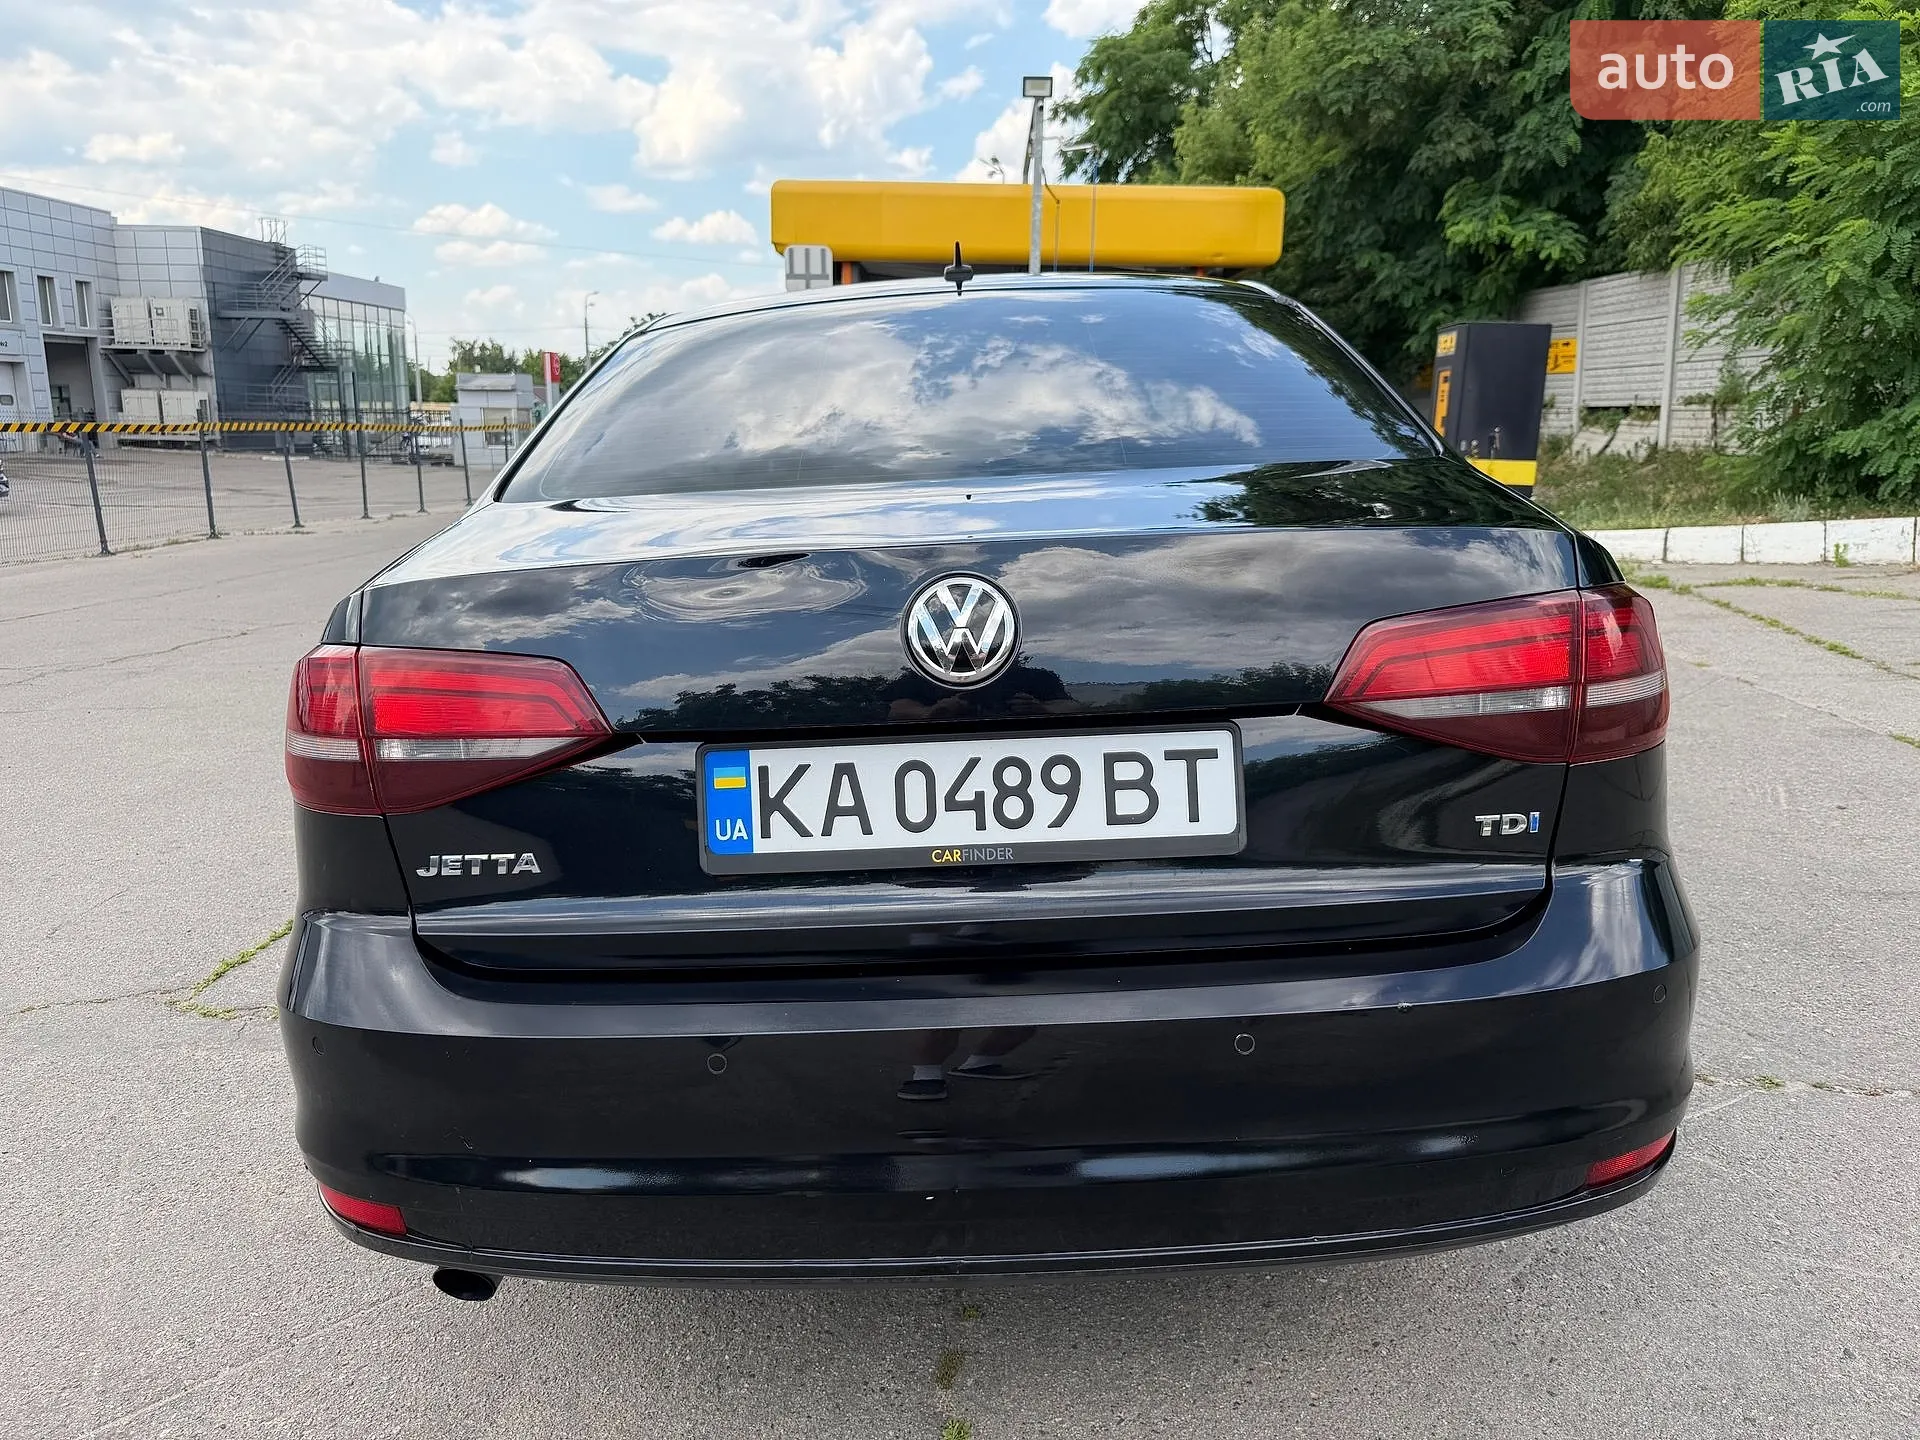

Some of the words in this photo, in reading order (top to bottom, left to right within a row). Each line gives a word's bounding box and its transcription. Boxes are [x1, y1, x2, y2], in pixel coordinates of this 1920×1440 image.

[715, 819, 748, 841] UA
[758, 762, 873, 839] KA
[894, 753, 1081, 834] 0489
[1103, 748, 1218, 826] BT
[1475, 811, 1540, 836] TDI
[416, 853, 541, 877] JETTA
[931, 848, 1014, 863] CARFINDER
